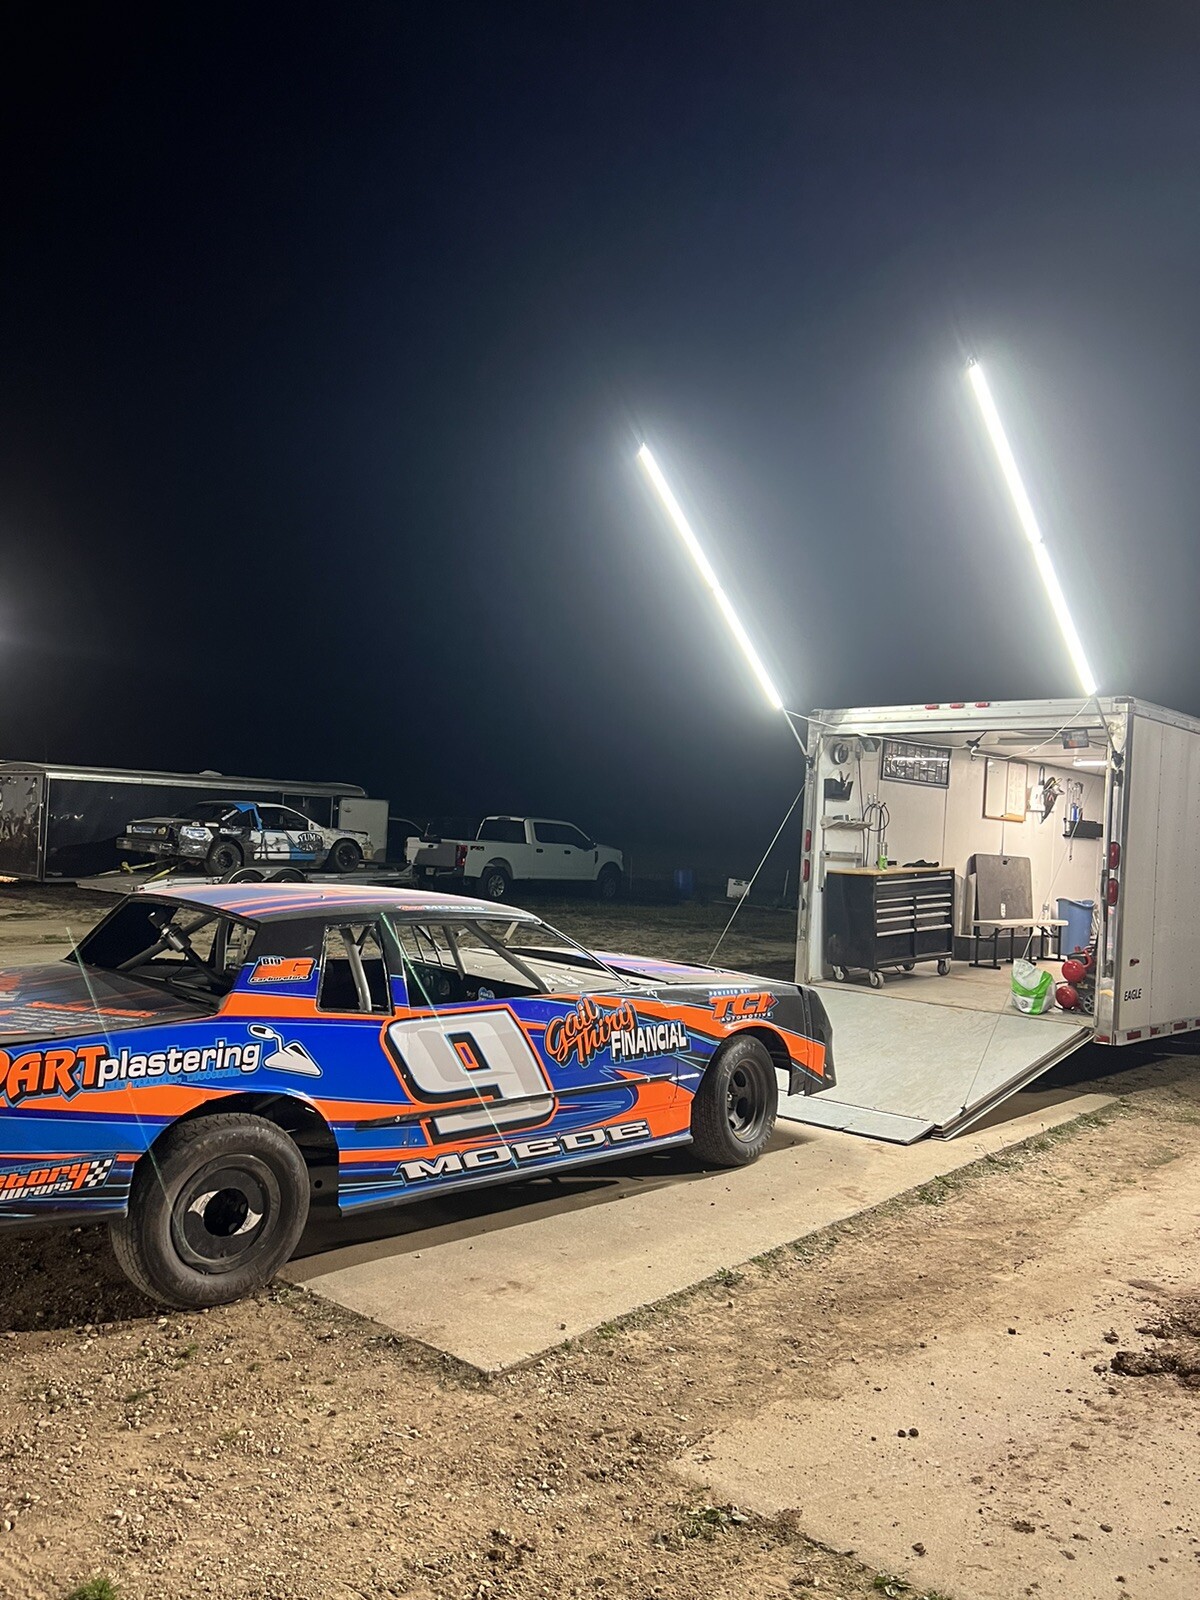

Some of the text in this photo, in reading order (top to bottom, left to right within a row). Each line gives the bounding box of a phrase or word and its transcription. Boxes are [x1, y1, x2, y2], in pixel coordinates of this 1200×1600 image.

[709, 992, 775, 1019] TCI
[721, 1011, 772, 1022] AUTOMOTIVE
[1123, 988, 1143, 1002] EAGLE
[545, 996, 598, 1062] Gail
[610, 1021, 688, 1058] FINANCIAL
[0, 1042, 261, 1101] ART plastering
[388, 1008, 556, 1136] 9
[400, 1120, 650, 1180] MOEDE
